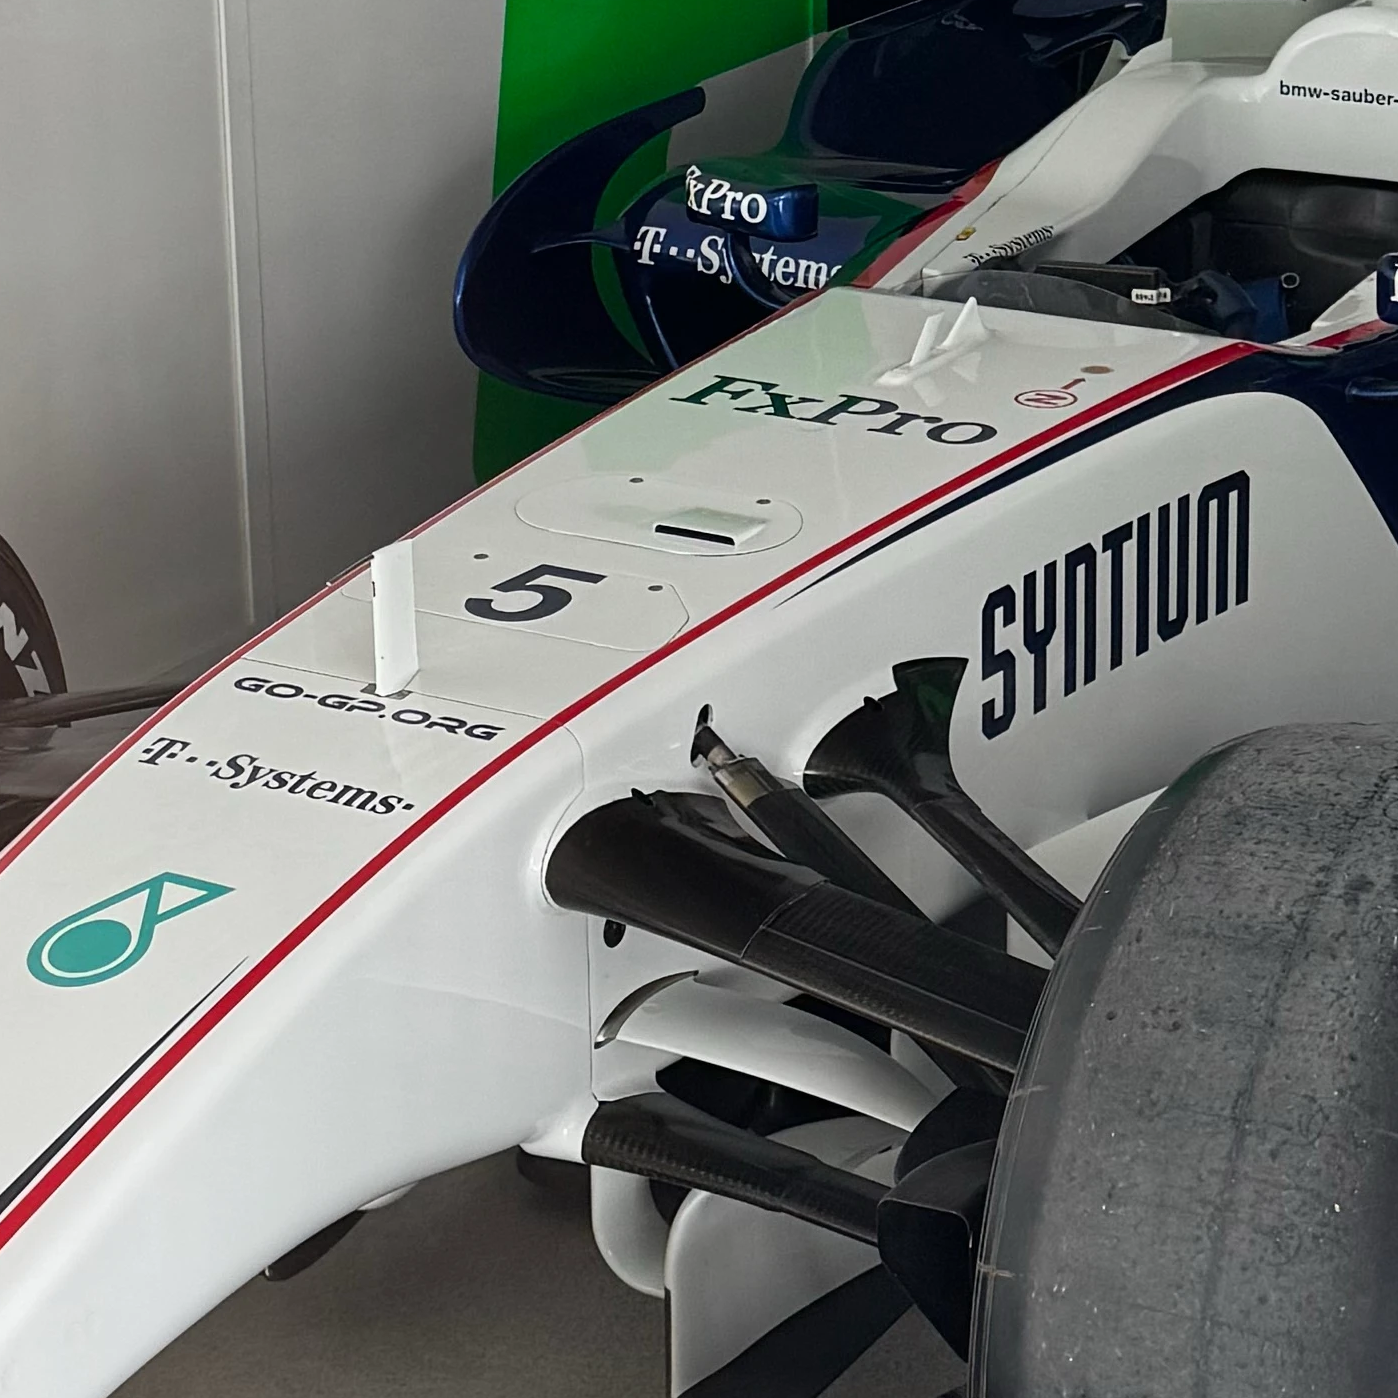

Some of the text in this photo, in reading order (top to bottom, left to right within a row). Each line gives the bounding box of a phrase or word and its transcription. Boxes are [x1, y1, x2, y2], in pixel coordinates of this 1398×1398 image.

[668, 373, 998, 447] FxPro
[464, 564, 608, 623] 5
[980, 469, 1250, 740] SYNTIUM
[234, 675, 505, 742] GO-GP.ORG
